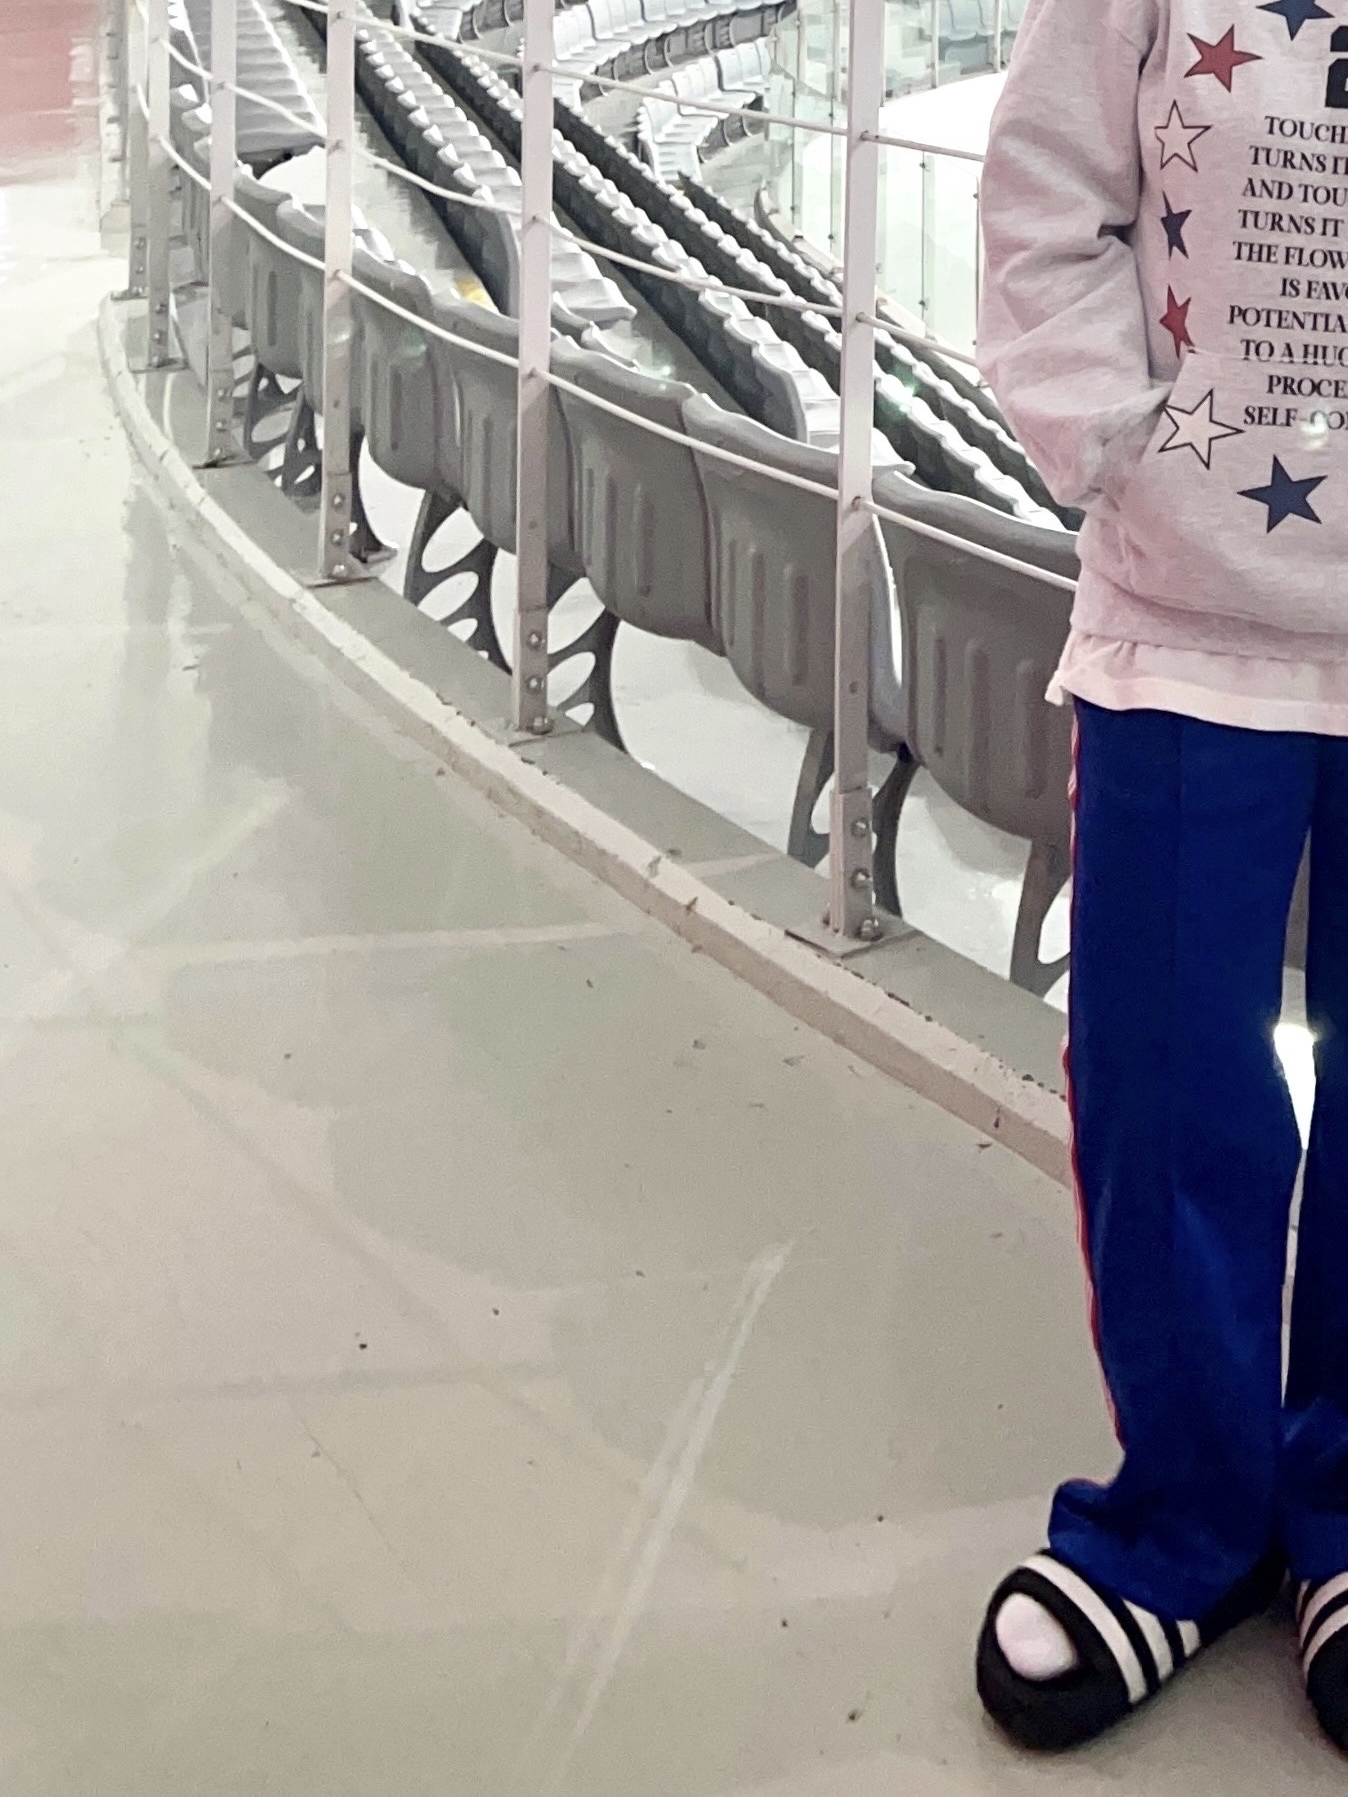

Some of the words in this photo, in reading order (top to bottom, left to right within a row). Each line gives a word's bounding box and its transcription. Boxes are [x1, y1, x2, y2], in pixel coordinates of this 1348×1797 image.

[1249, 145, 1327, 175] TURNS
[1241, 177, 1294, 201] AND
[1238, 208, 1316, 237] TURNS
[1320, 217, 1344, 238] IT
[1232, 240, 1279, 264] THE
[1280, 277, 1300, 299] IS
[1240, 338, 1275, 362] TO
[1279, 342, 1297, 365] A
